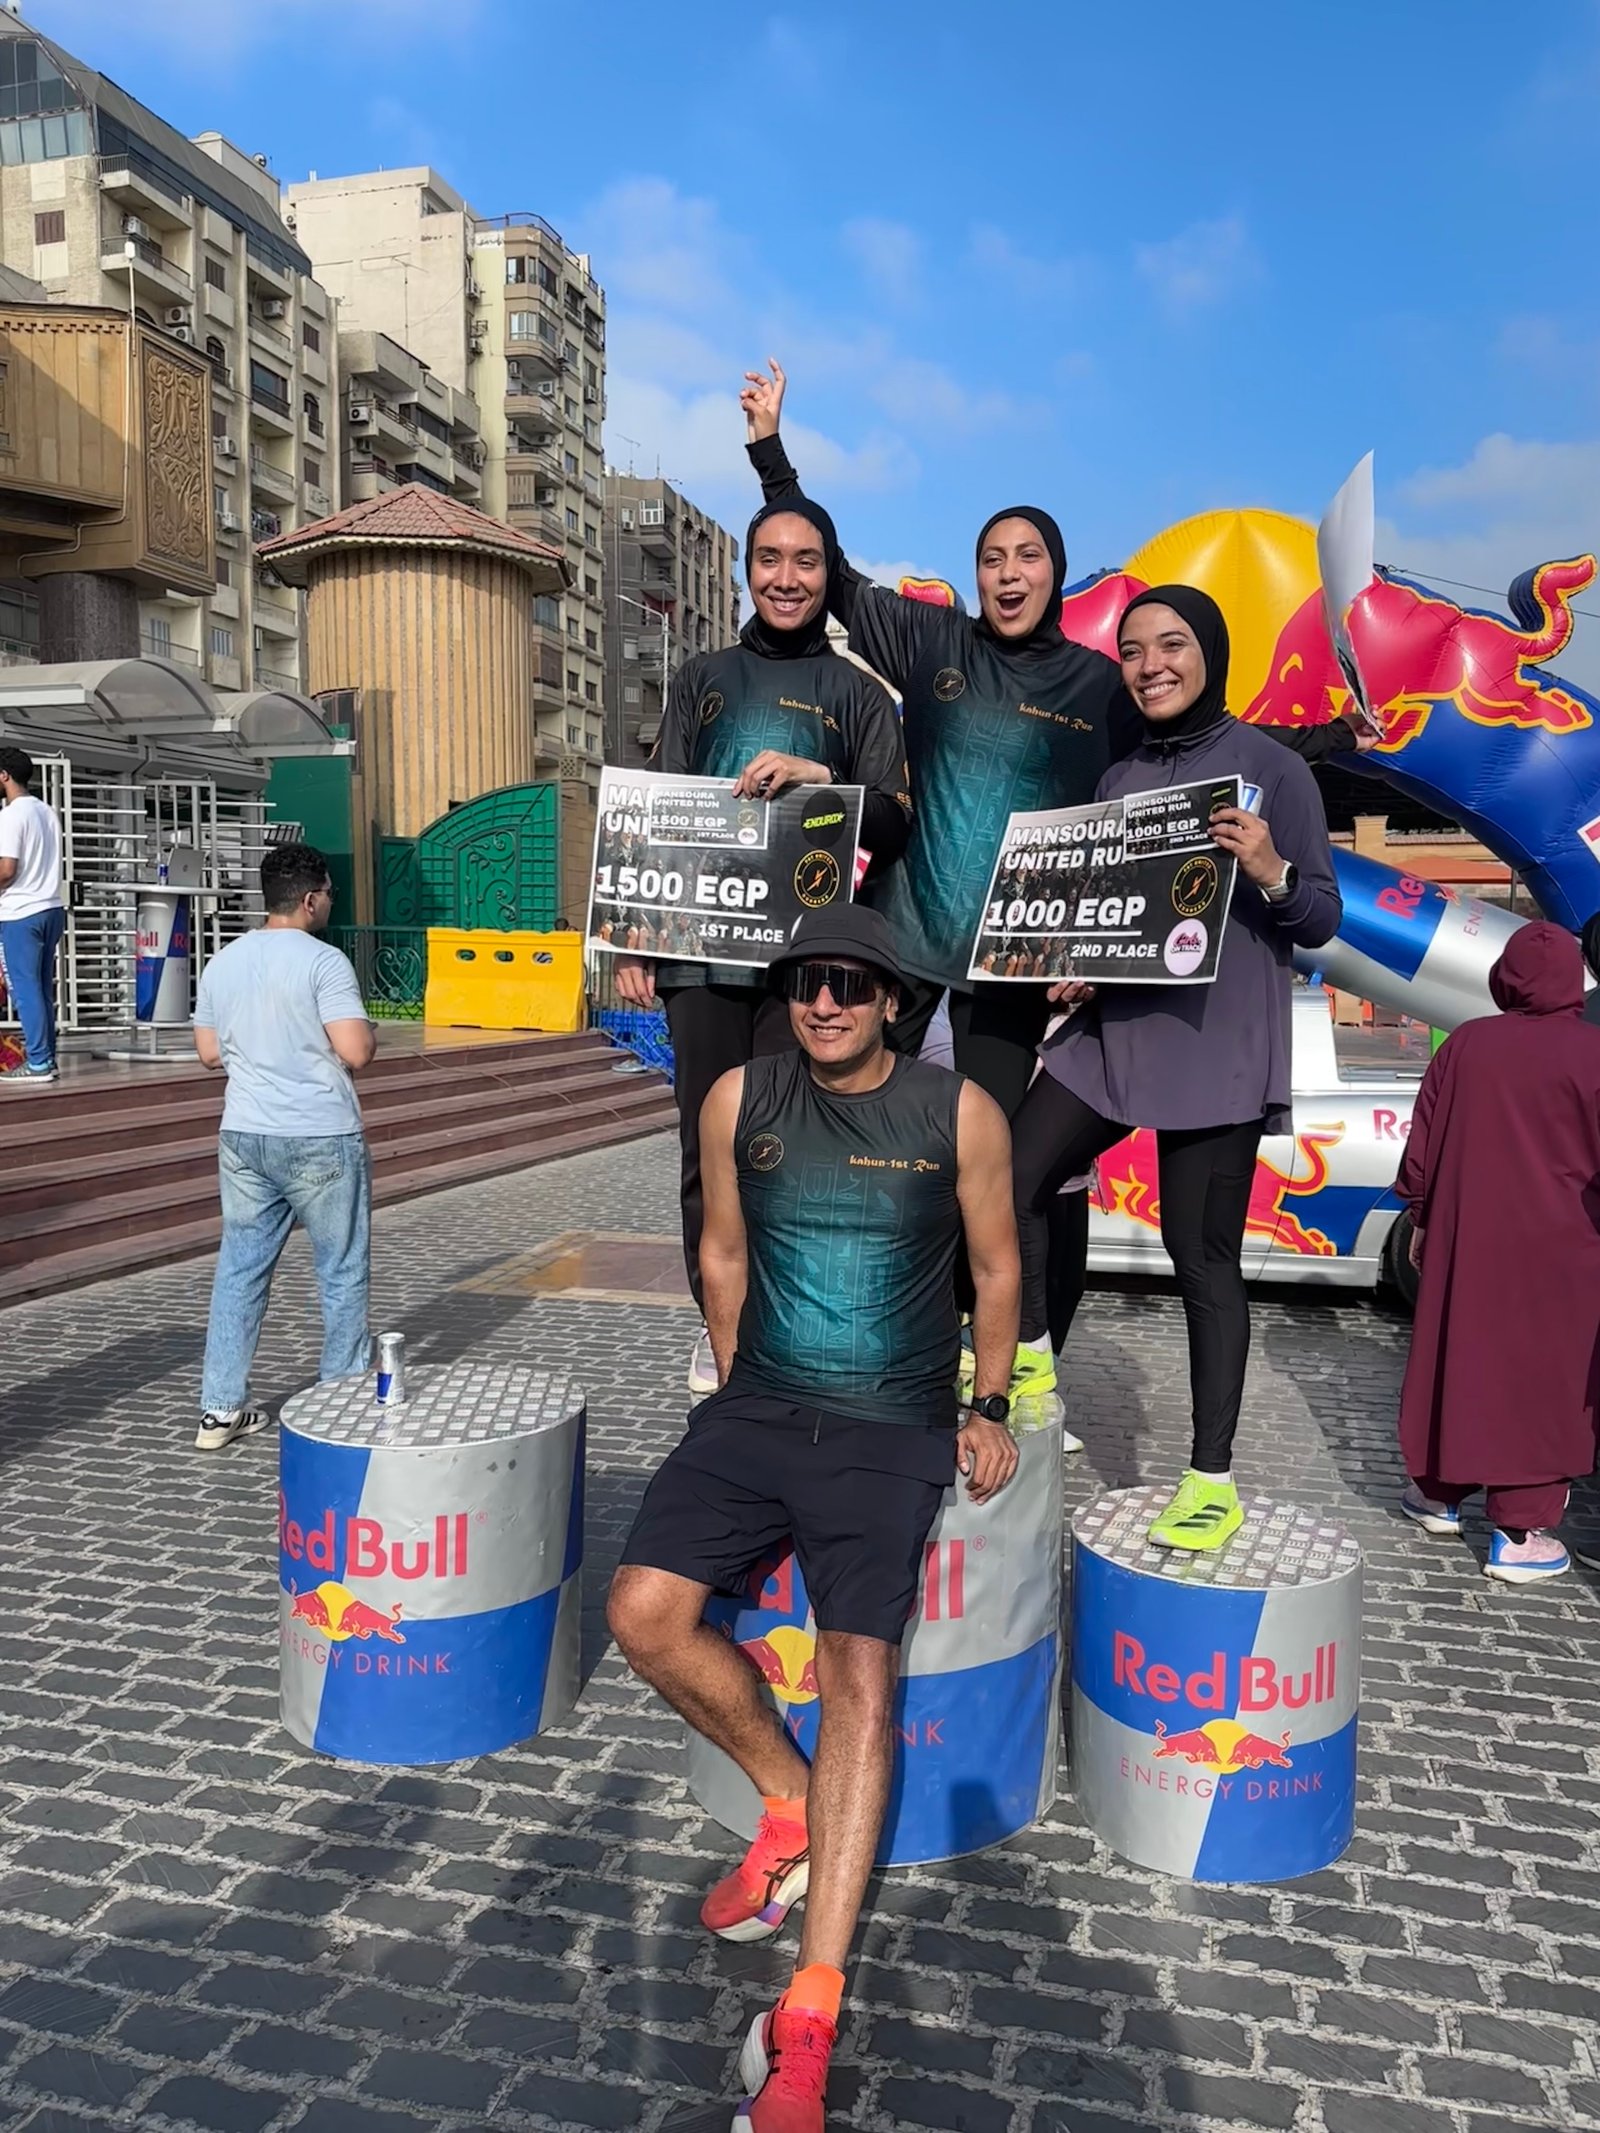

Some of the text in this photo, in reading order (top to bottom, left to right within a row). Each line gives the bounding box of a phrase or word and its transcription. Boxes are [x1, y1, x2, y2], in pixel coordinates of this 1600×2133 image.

[823, 715, 840, 733] Ru
[1070, 718, 1094, 732] Run
[654, 797, 720, 809] UNITED RUN
[1127, 793, 1186, 809] MANSOURA
[1127, 801, 1192, 819] UNITED RUN
[605, 811, 649, 836] UNI
[652, 814, 727, 829] 1500 EGP
[1127, 817, 1200, 840] 1000 EGP
[711, 831, 736, 840] PLACE
[1169, 832, 1208, 844] 2ND PLACE
[1004, 845, 1125, 870] UNITED RU
[596, 864, 769, 909] 1500 EGP
[1376, 872, 1426, 920] Re
[985, 895, 1147, 928] 1000 EGP
[699, 922, 785, 944] 1ST PLACE
[1070, 943, 1158, 959] 2ND PLACE
[1373, 1109, 1412, 1140] Re
[849, 1154, 941, 1173] kahun-1st Run
[346, 1512, 469, 1580] Bull
[925, 1539, 965, 1622] ll
[281, 1623, 451, 1677] NERGY DRINK
[1113, 1630, 1337, 1713] Red Bull
[1120, 1756, 1324, 1802] ENERGY DRINK
